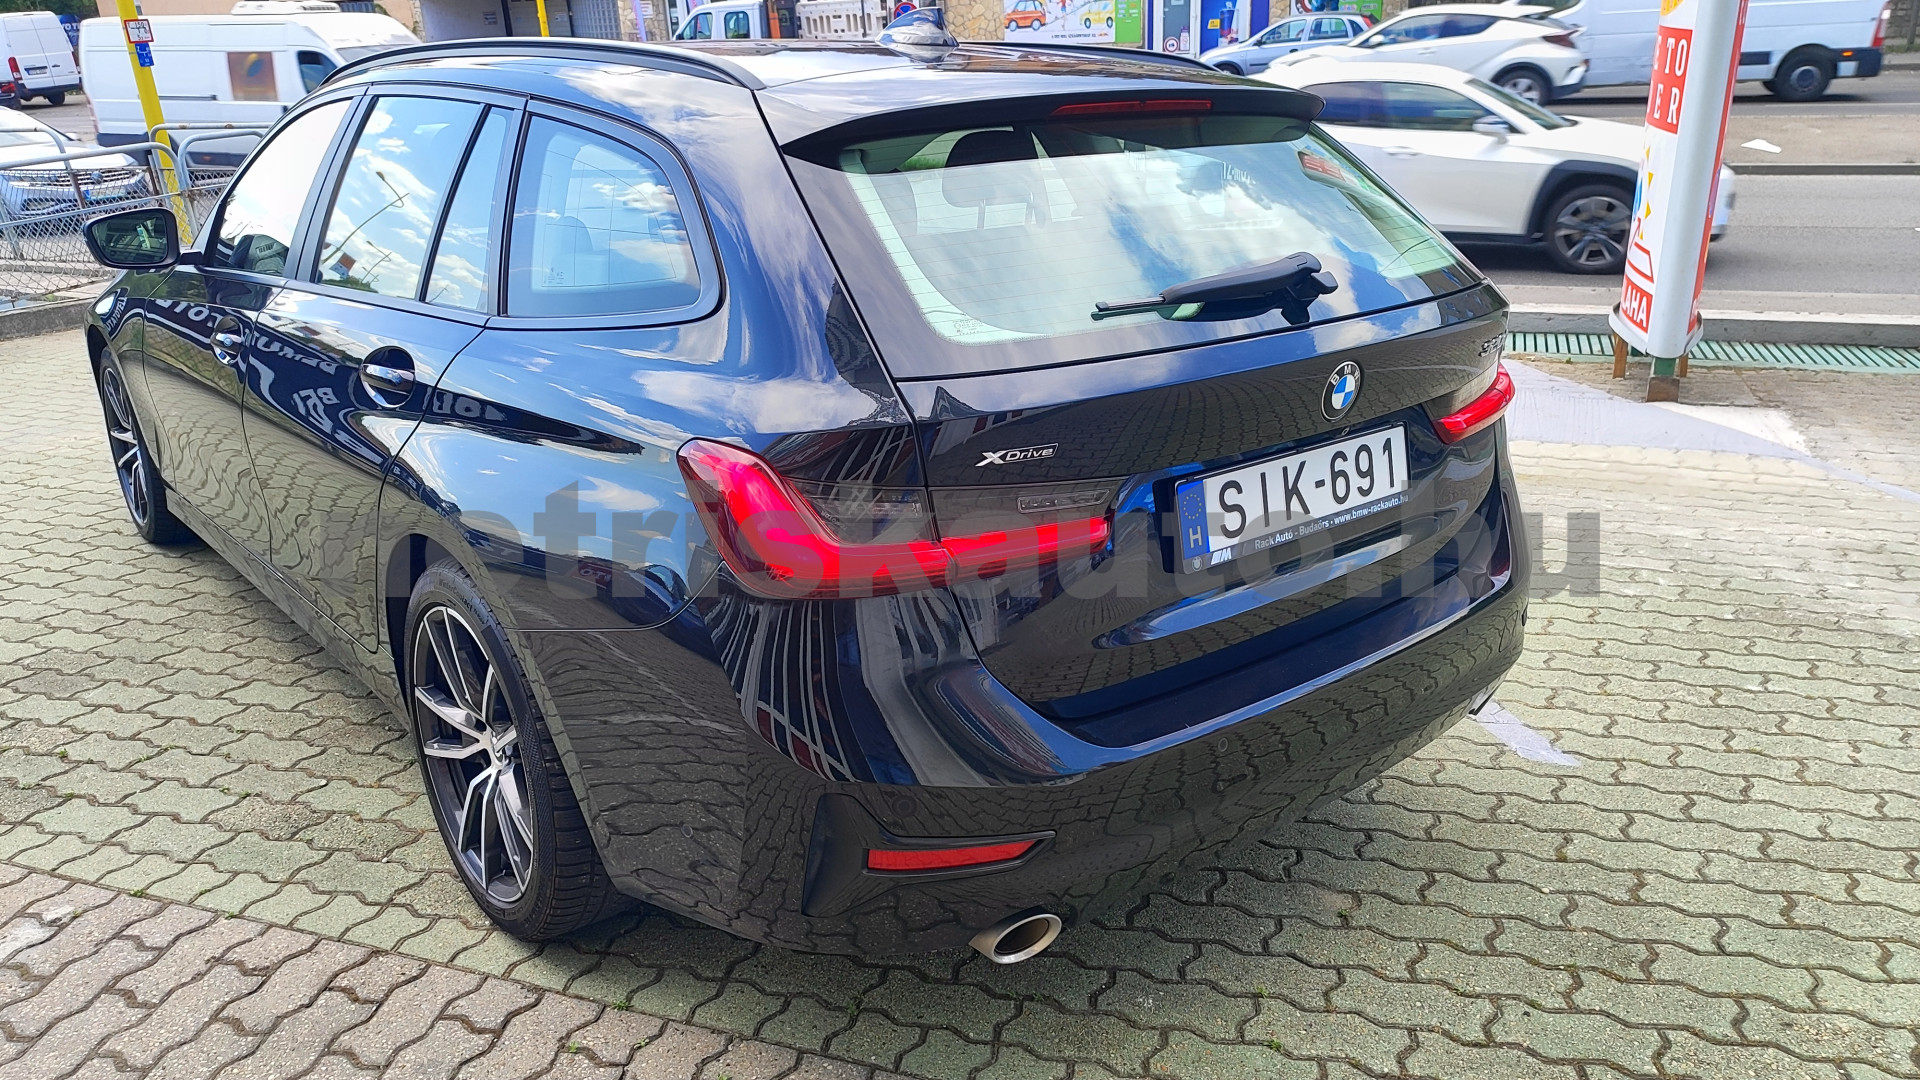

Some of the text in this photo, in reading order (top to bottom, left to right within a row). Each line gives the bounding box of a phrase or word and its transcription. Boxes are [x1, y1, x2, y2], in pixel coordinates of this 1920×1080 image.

[1330, 364, 1360, 386] BMW
[1218, 437, 1395, 539] SIK-691
[1189, 525, 1203, 549] H
[1254, 536, 1275, 550] Rack
[1275, 529, 1294, 543] Autó
[1333, 494, 1409, 525] www.bmw-rackauto.hu
